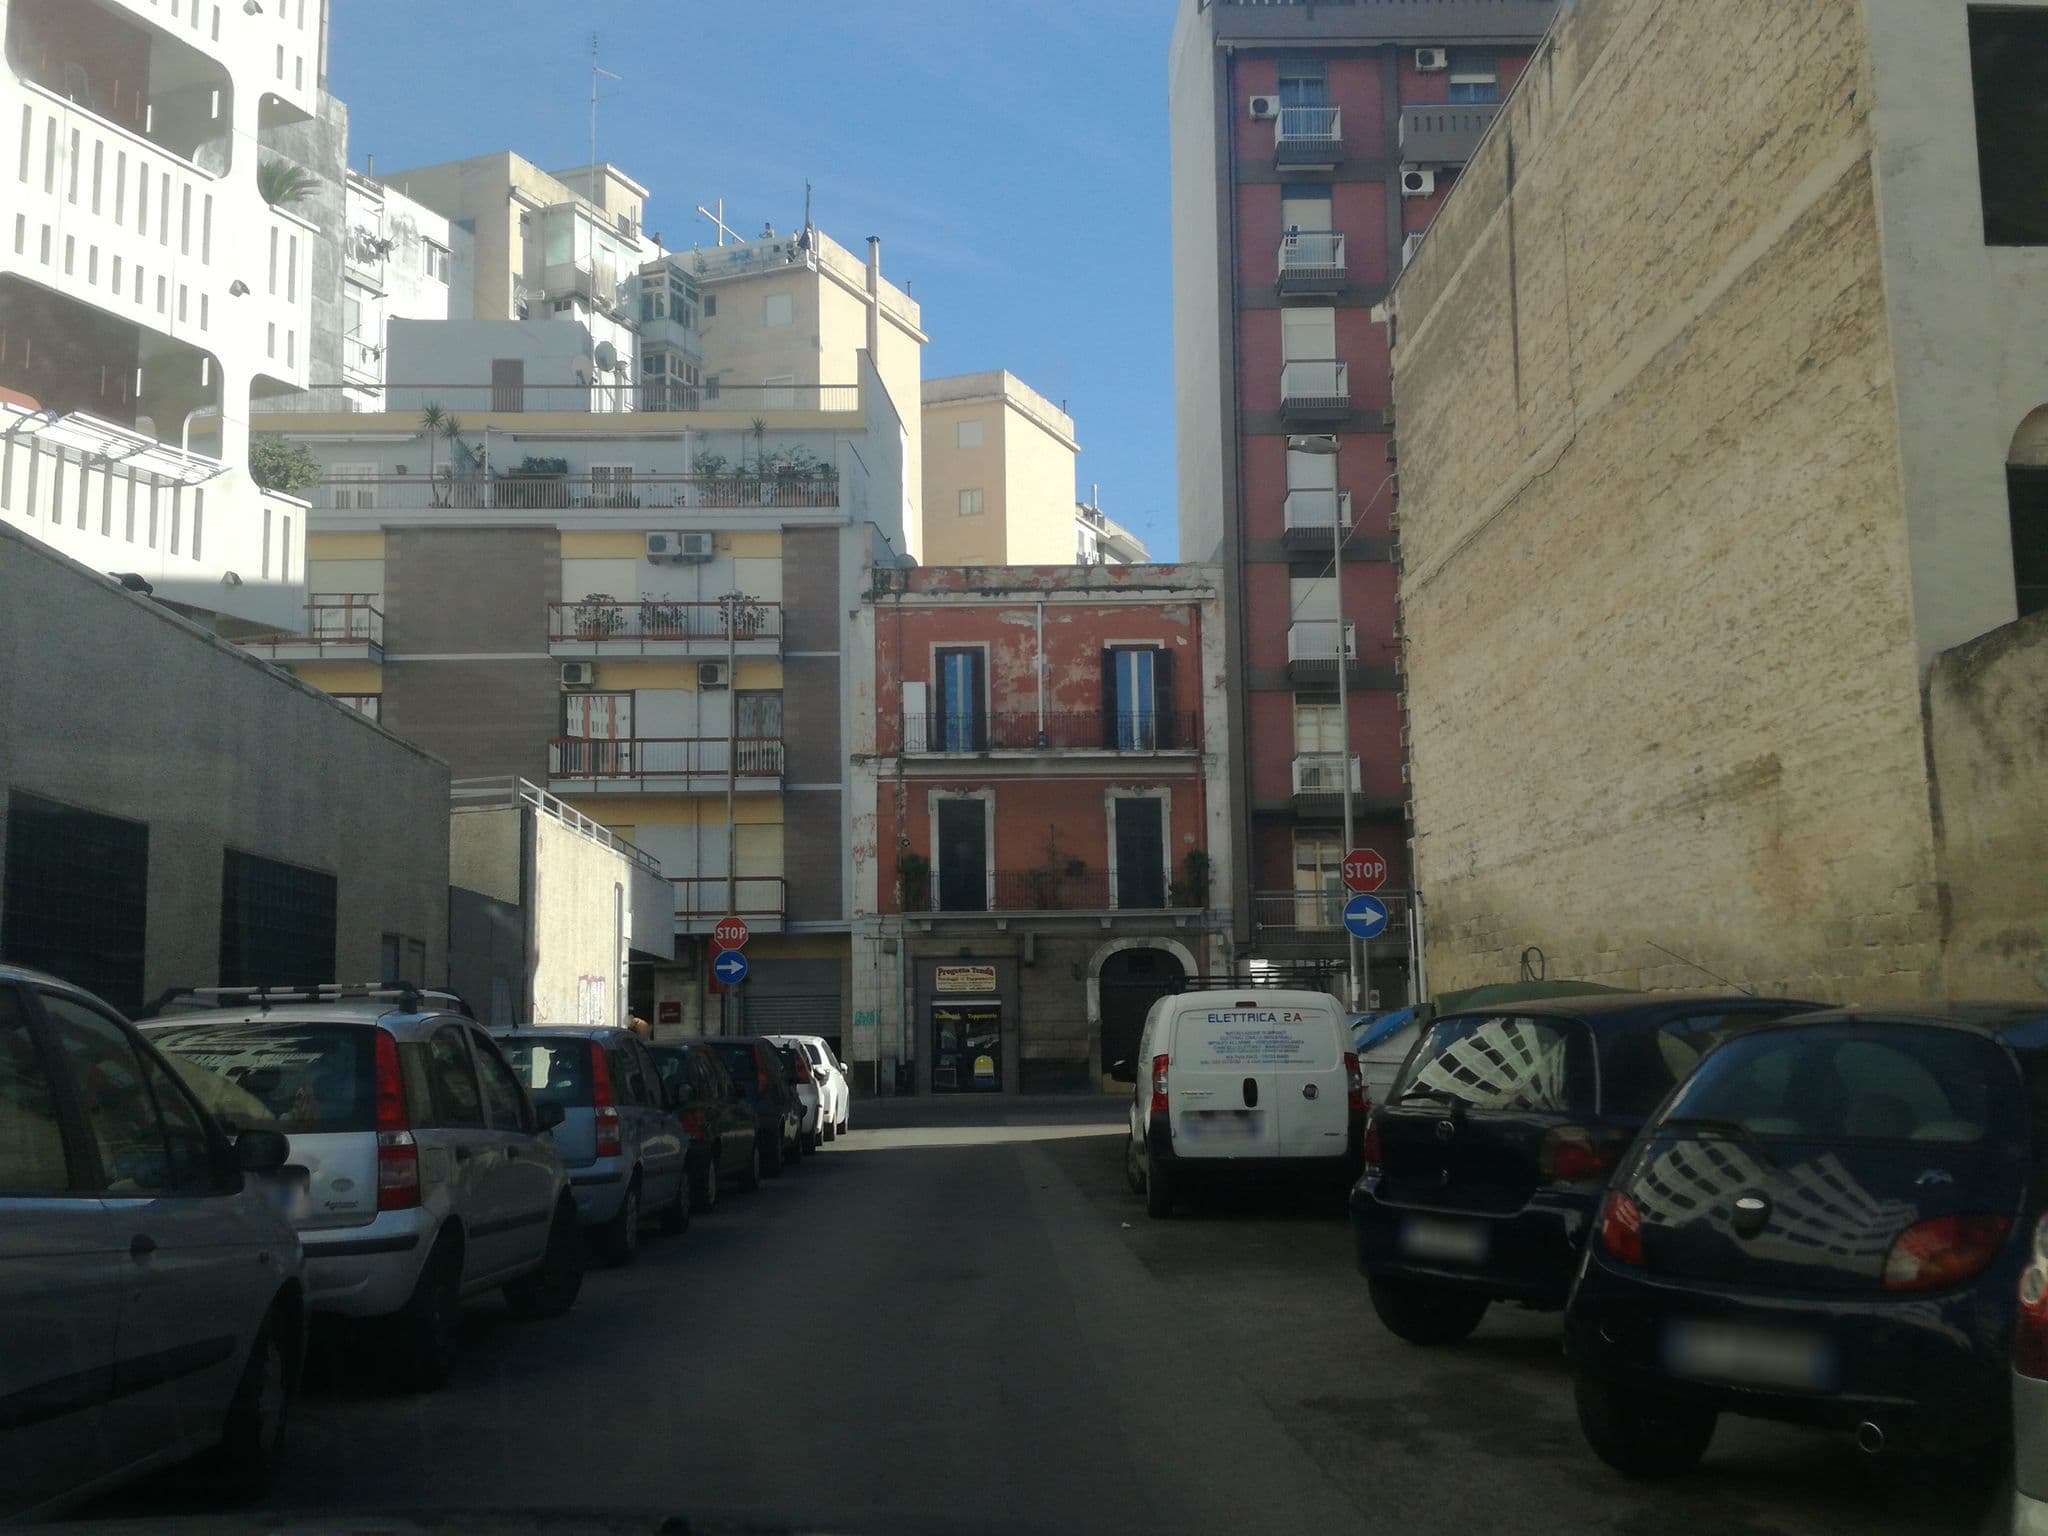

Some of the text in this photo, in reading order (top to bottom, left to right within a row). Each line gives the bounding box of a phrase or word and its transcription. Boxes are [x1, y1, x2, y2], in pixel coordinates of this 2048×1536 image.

[1345, 862, 1383, 878] STOP
[717, 927, 745, 939] STOP
[1207, 1012, 1277, 1023] ELETTRICA
